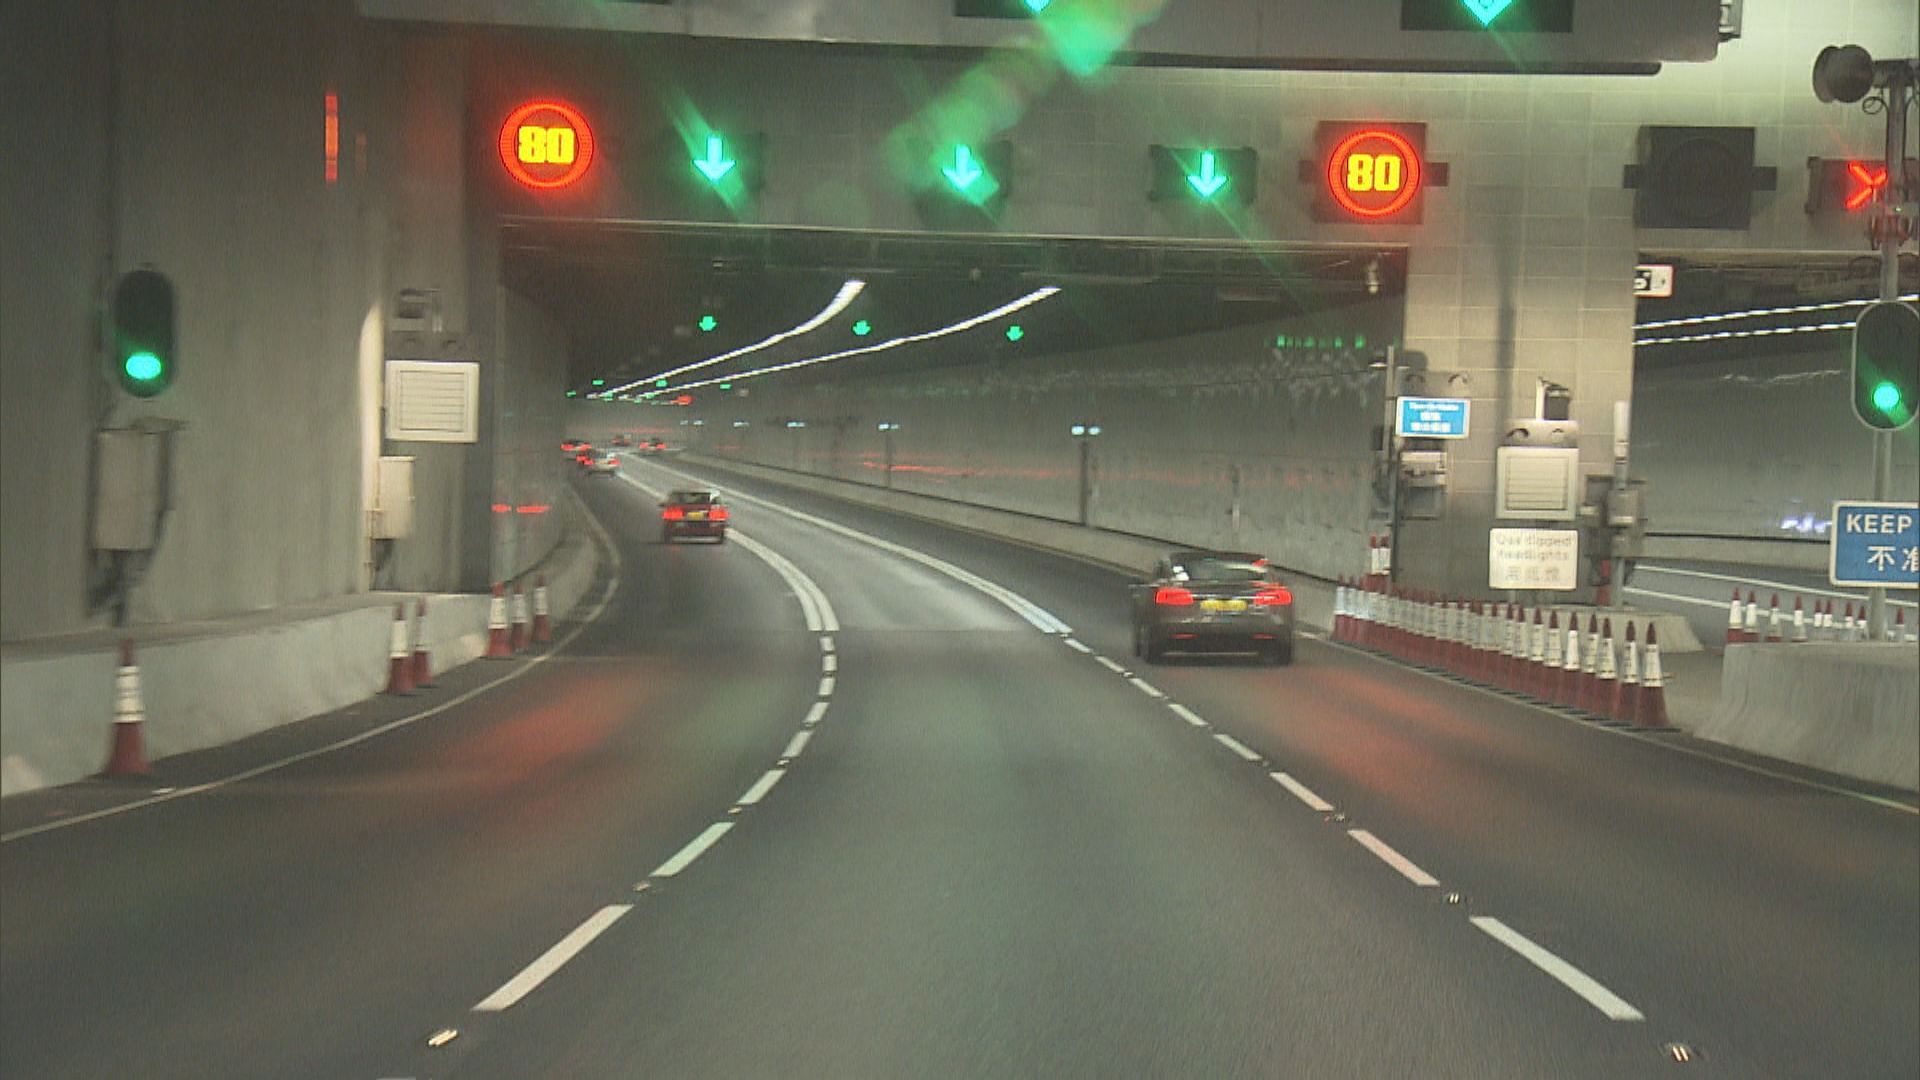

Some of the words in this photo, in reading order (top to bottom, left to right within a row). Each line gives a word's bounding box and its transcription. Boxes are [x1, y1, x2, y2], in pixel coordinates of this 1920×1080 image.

[519, 126, 574, 163] 80
[1347, 154, 1400, 191] 80
[1846, 514, 1912, 533] KEEP
